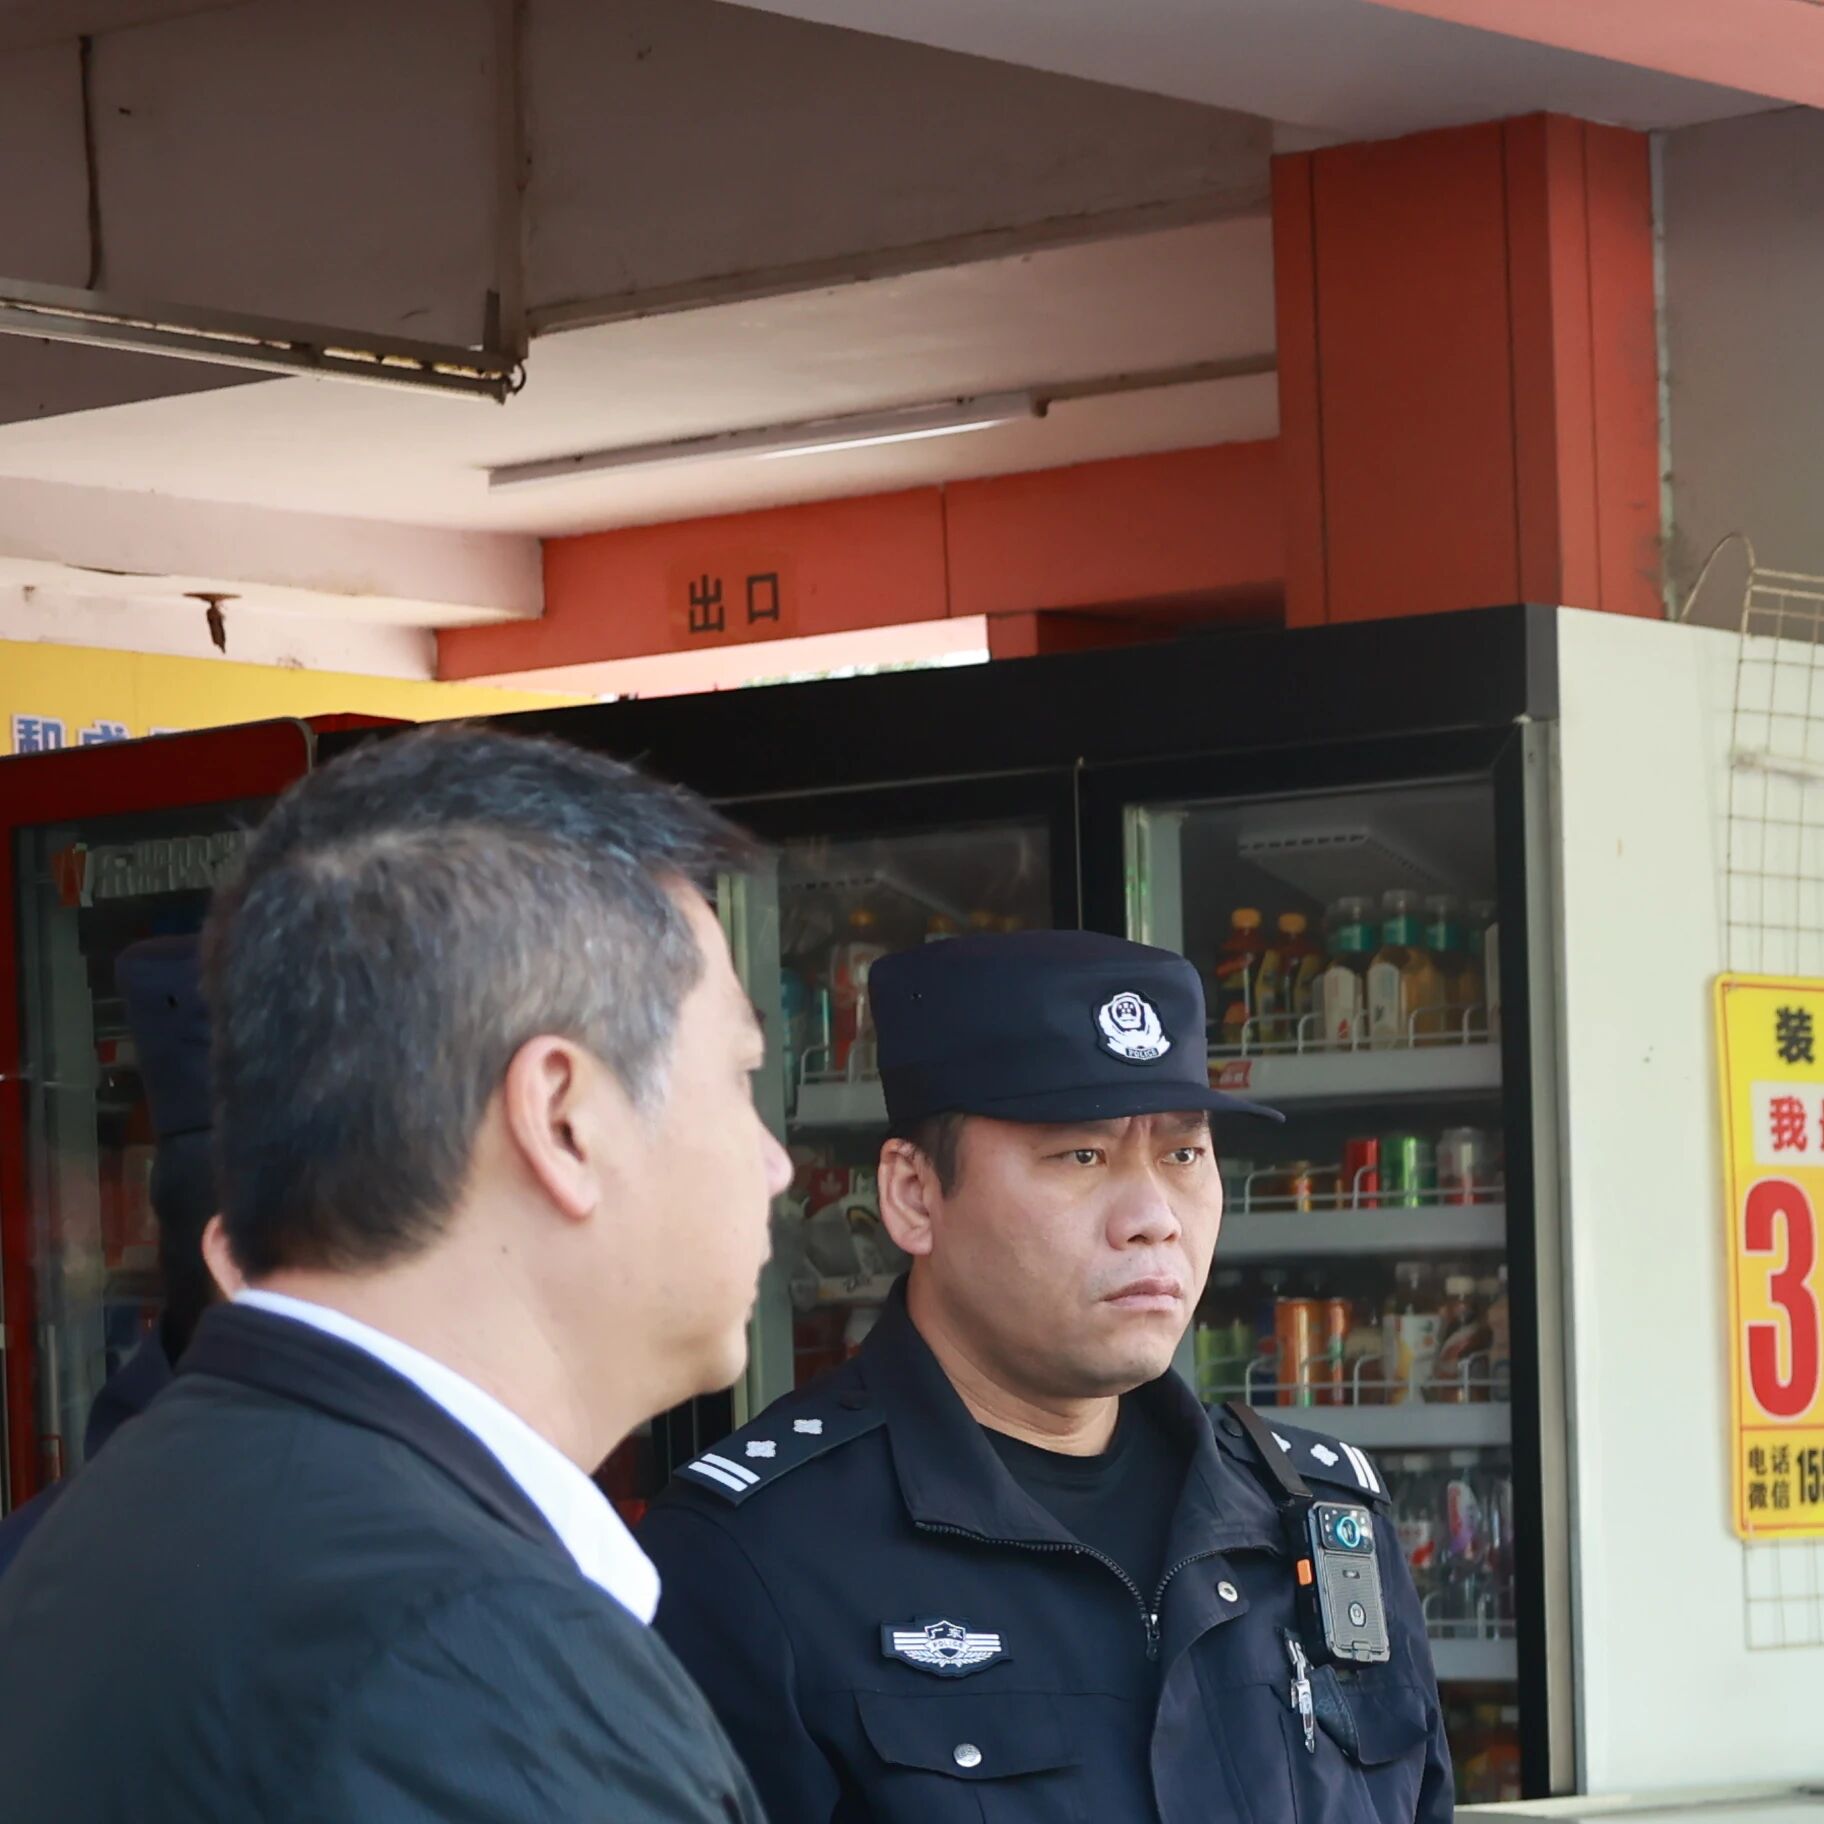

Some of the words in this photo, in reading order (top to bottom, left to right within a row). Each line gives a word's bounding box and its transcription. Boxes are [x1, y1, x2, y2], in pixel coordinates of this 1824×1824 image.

[689, 573, 780, 633] 出口
[1127, 1049, 1158, 1058] POLICE
[1749, 1444, 1790, 1476] 电话
[1749, 1480, 1790, 1510] 微信
[932, 1640, 964, 1649] POLICE
